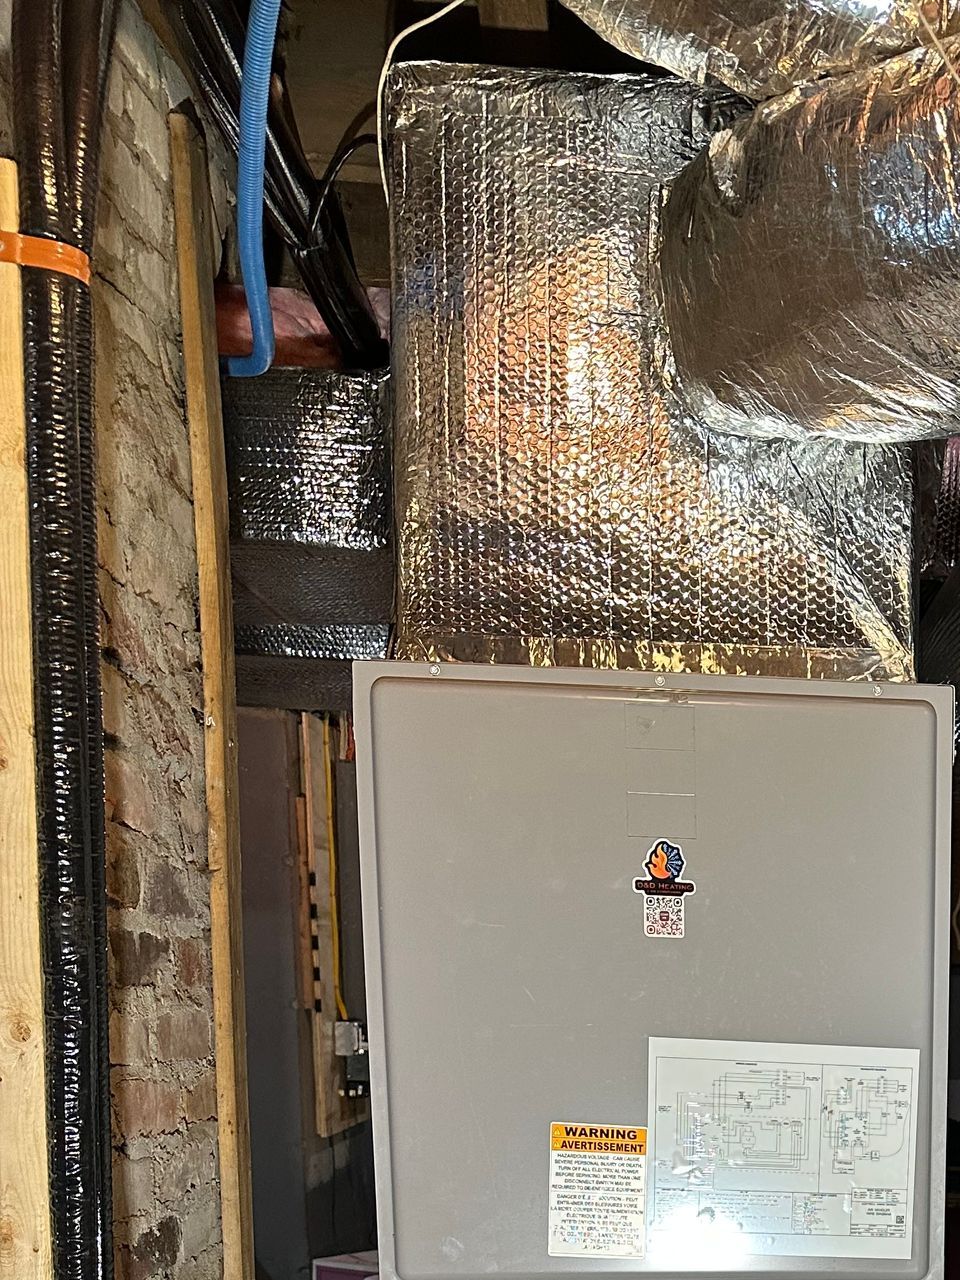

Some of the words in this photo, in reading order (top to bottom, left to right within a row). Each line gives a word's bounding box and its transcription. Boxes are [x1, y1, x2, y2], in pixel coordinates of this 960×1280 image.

[658, 883, 693, 891] HEATING
[565, 1126, 637, 1140] WARNING
[561, 1140, 644, 1153] AVERTISSEMENT
